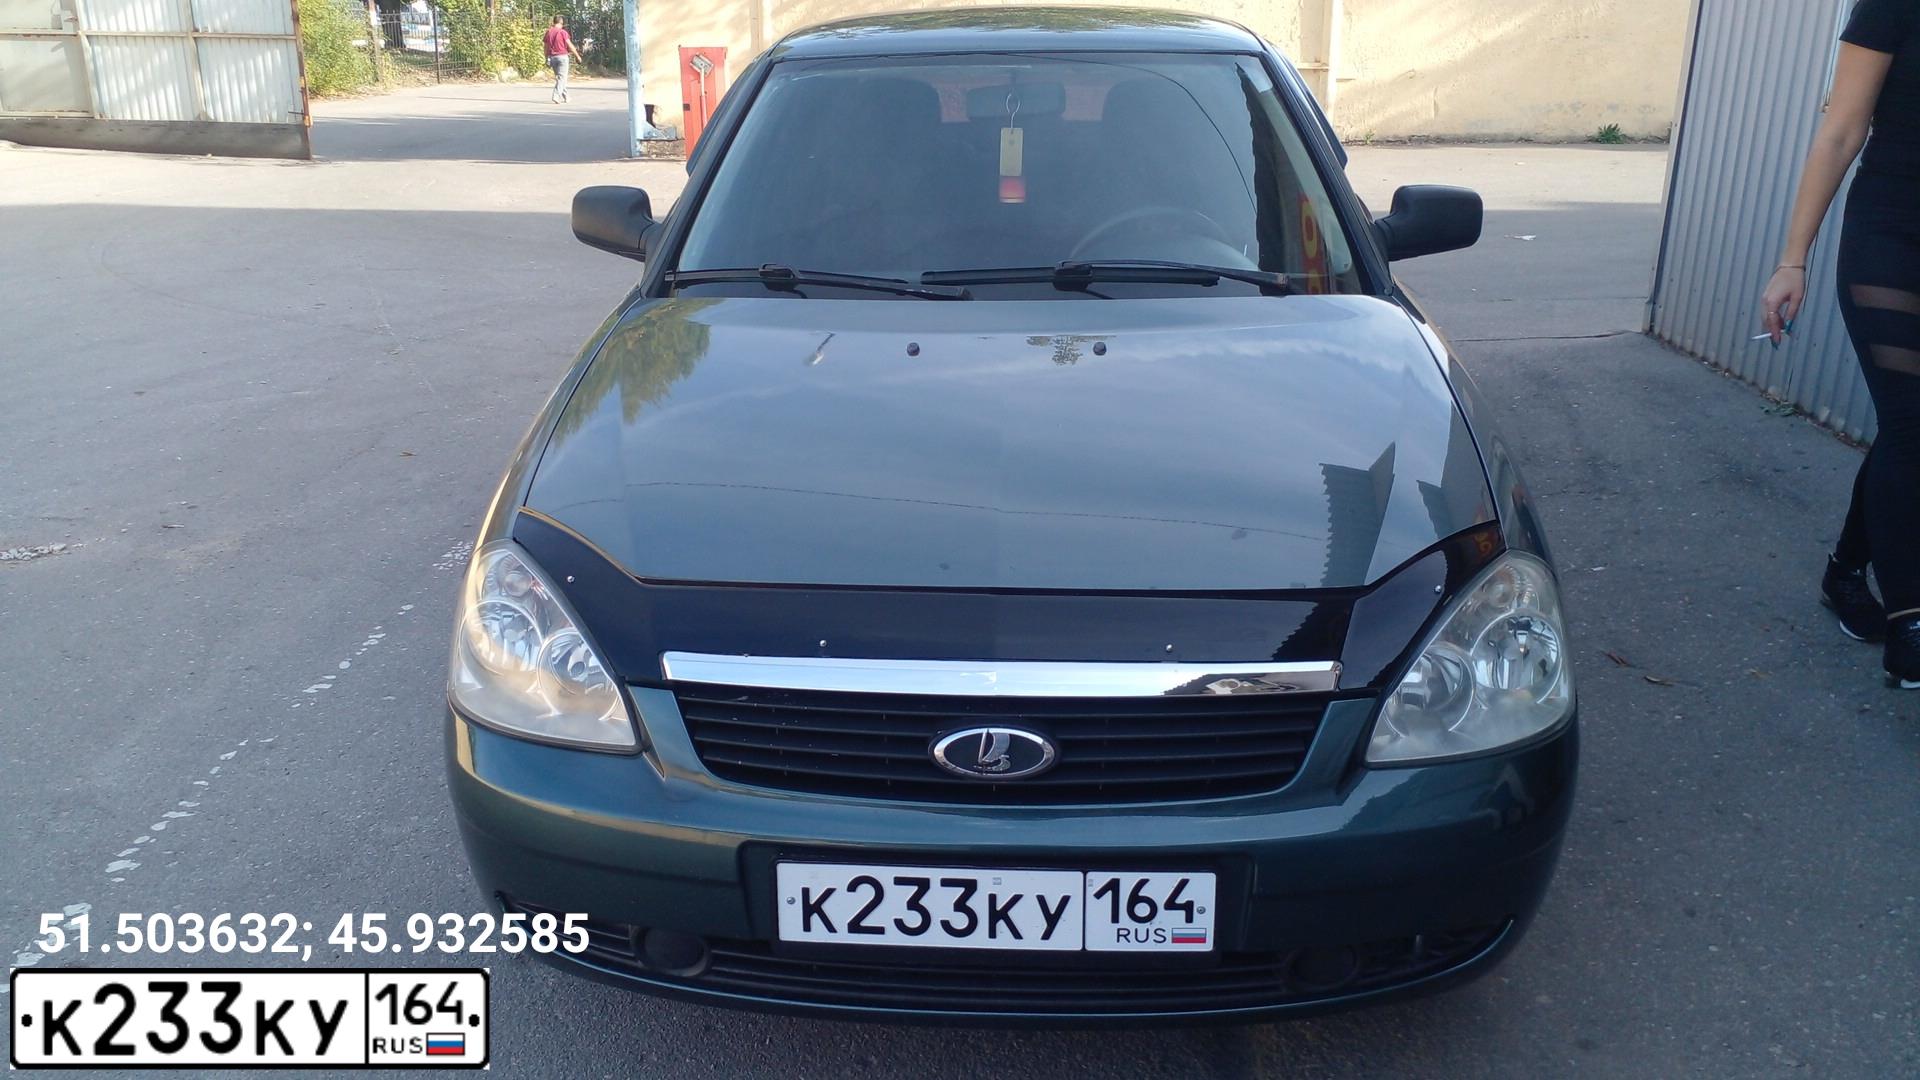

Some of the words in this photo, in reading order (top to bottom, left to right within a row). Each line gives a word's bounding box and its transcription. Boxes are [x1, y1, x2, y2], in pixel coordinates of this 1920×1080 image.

[800, 874, 1072, 941] К233КУ
[1093, 877, 1195, 924] 164
[1115, 927, 1167, 944] RUS
